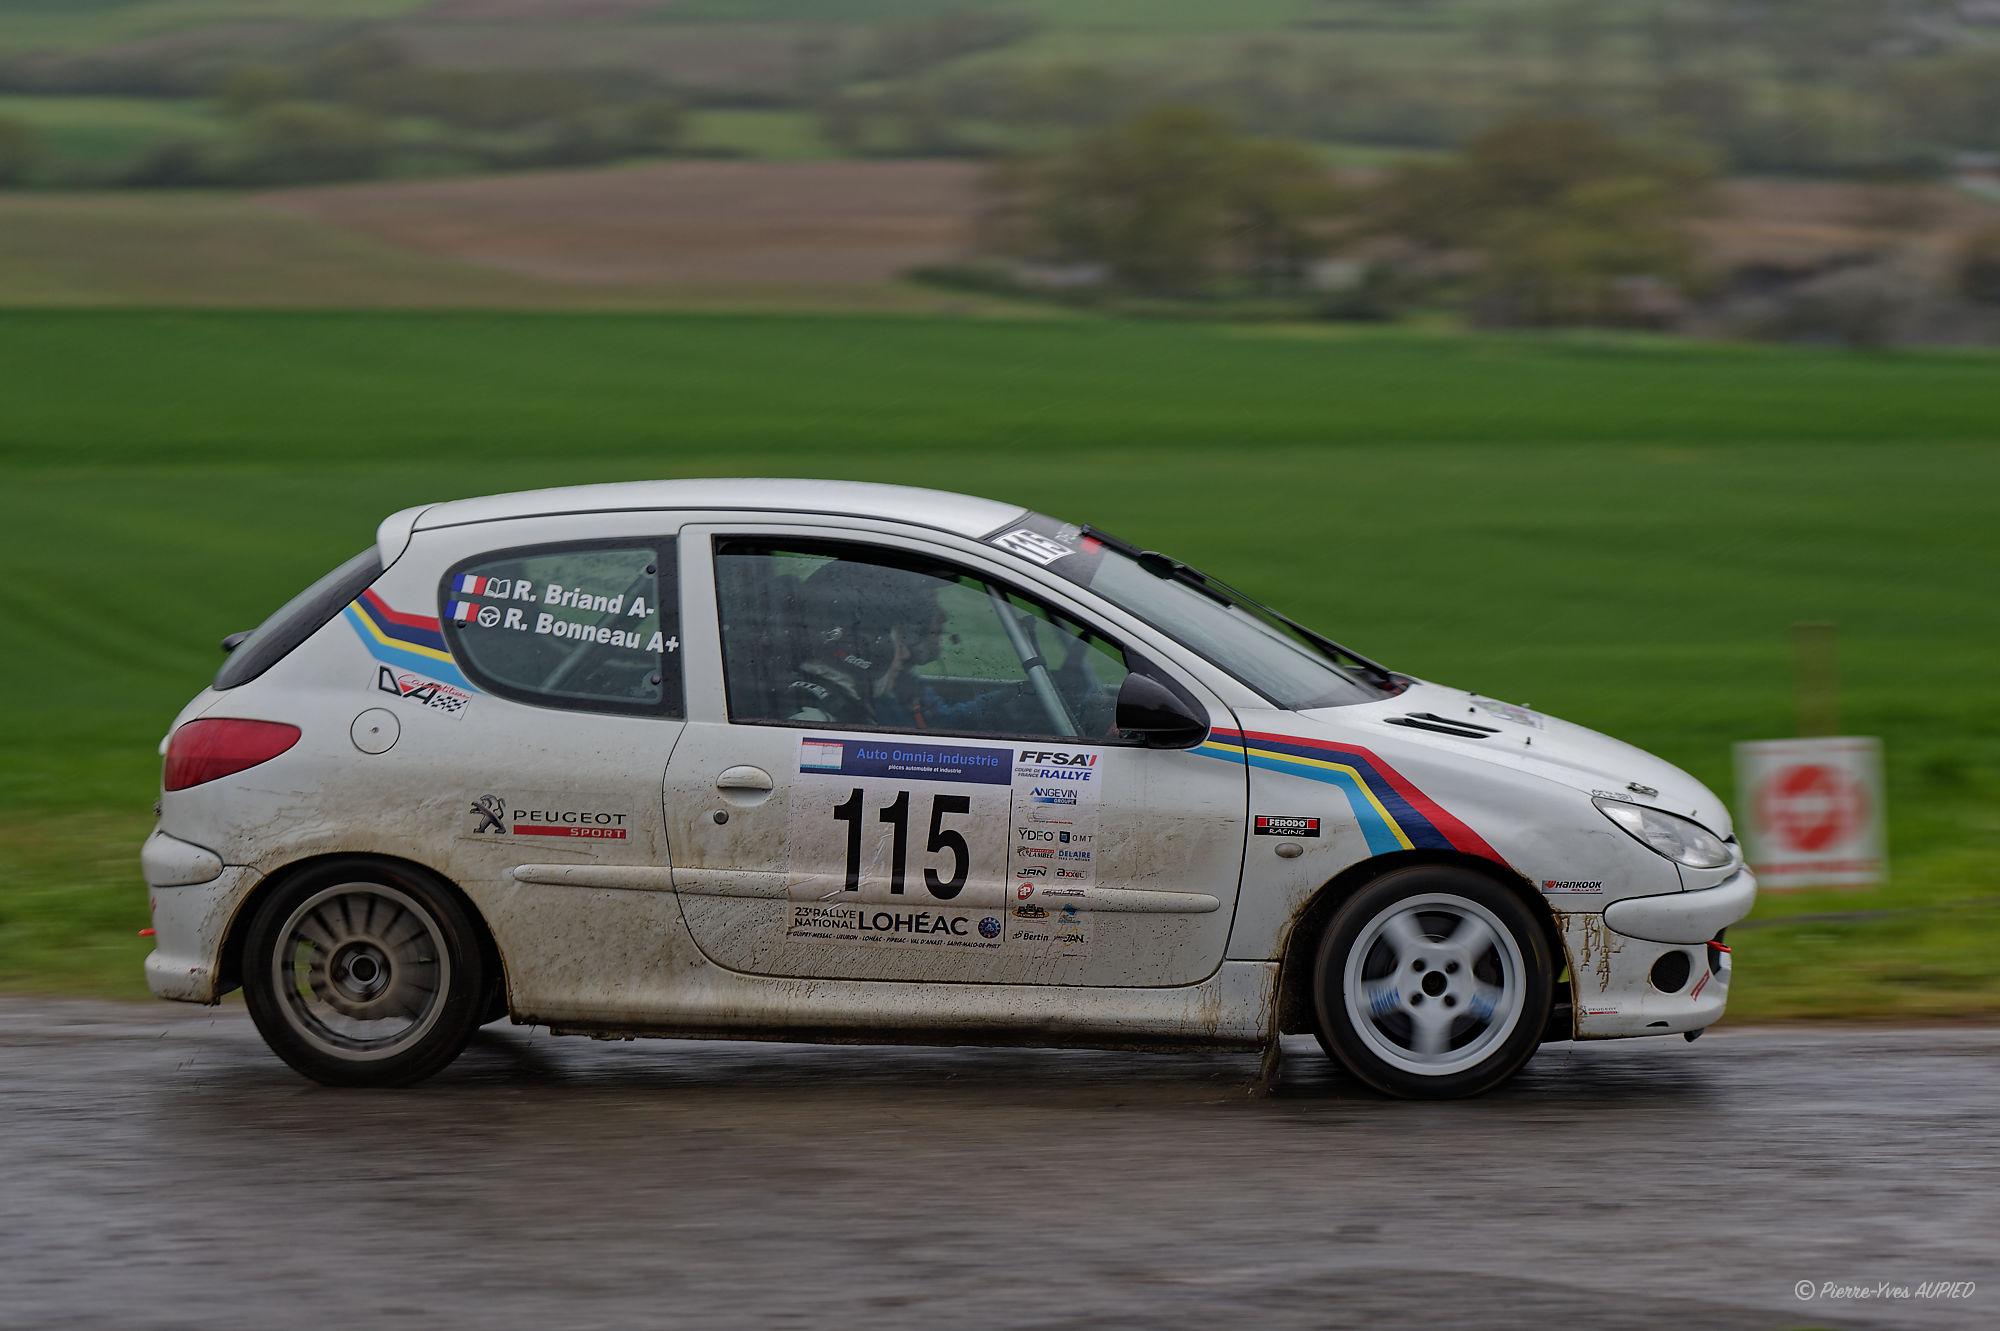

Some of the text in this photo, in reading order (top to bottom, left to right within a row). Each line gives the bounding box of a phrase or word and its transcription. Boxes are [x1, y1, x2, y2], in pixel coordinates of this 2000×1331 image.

[512, 579, 655, 618] R. Briand A-
[503, 607, 679, 653] R. Bonneau A+
[857, 748, 999, 767] Auto Omnia Industrie
[1019, 750, 1087, 767] FFSA
[1040, 769, 1092, 781] RALLYE
[1030, 787, 1078, 798] ANGEVIN
[513, 810, 627, 825] PEUGEOT
[1269, 819, 1306, 828] FERODO
[570, 828, 624, 838] SPORT
[1269, 828, 1305, 836] RACING
[833, 789, 970, 900] 115
[1058, 850, 1091, 858] DELAIRE
[813, 908, 856, 919] RALLYE
[795, 918, 855, 930] NATIONAL
[858, 911, 968, 936] LOHÉAC
[1023, 932, 1049, 941] Bertin
